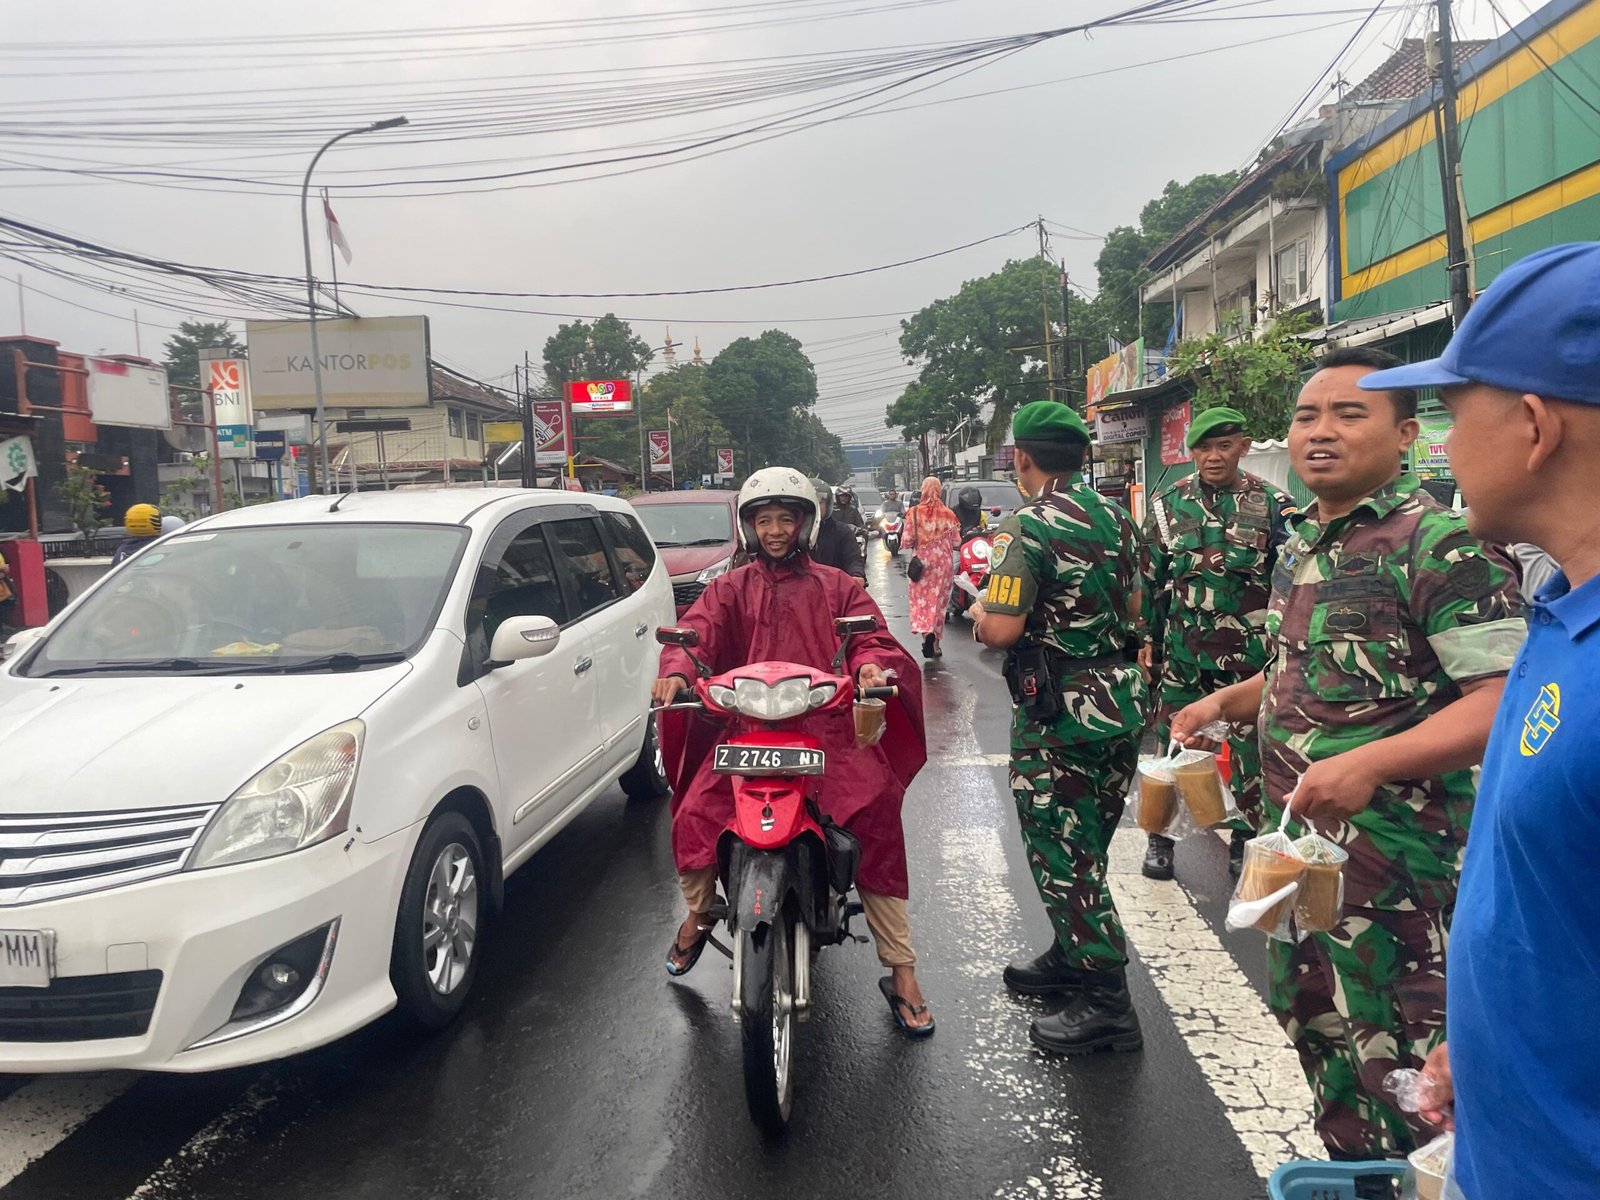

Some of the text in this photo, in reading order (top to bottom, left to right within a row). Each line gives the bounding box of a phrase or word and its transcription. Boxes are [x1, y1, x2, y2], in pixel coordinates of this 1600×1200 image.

[215, 393, 240, 406] BNI
[1101, 409, 1145, 423] Canon
[217, 428, 232, 436] ATM
[1103, 433, 1125, 441] DIGITAL
[718, 749, 729, 766] Z
[739, 750, 782, 767] 2746
